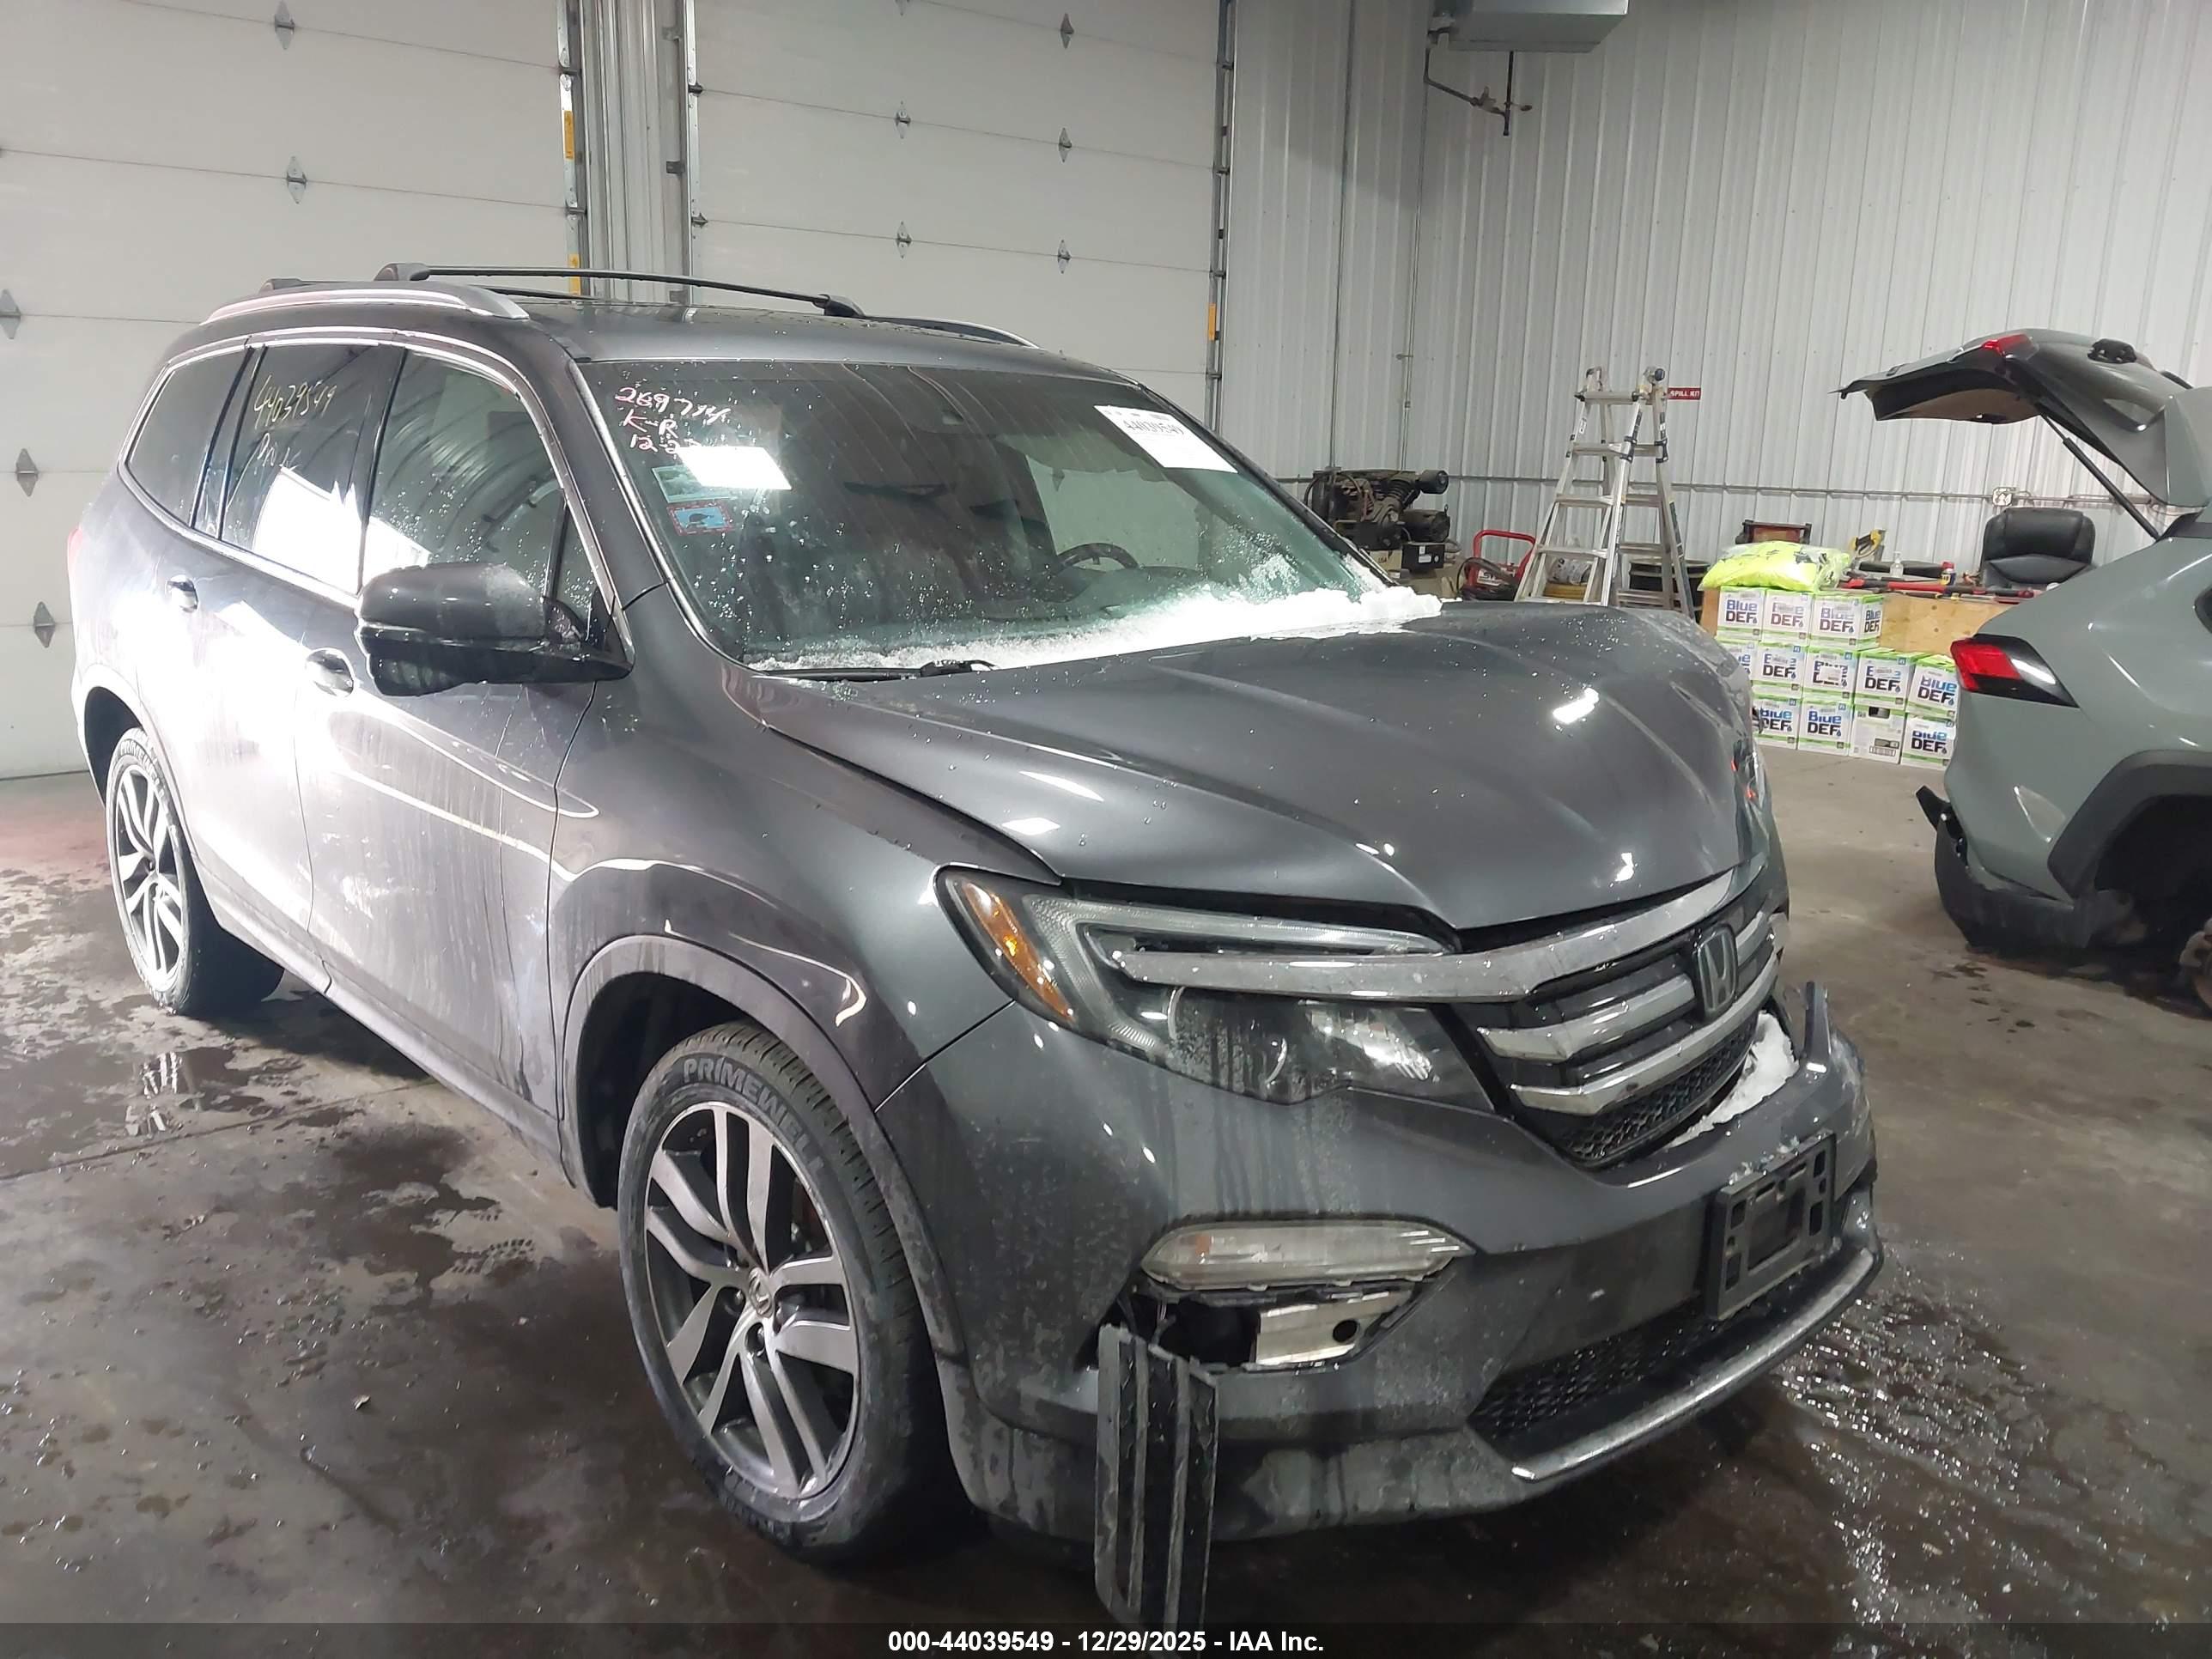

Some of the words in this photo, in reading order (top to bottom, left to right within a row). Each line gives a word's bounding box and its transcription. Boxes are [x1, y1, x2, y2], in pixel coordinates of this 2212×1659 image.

[1726, 599, 1758, 611] Blue
[1725, 611, 1757, 623] DEF
[1771, 613, 1803, 626] DEF
[1866, 610, 1881, 620] Blue
[1820, 619, 1854, 632] DEF
[1864, 620, 1881, 633] DEF
[1762, 665, 1796, 678] DEF
[1864, 677, 1901, 691] DEF
[1917, 686, 1955, 703] DEF
[1808, 710, 1842, 724] Blue
[1807, 722, 1842, 736] DEF
[1911, 738, 1947, 753] DEF
